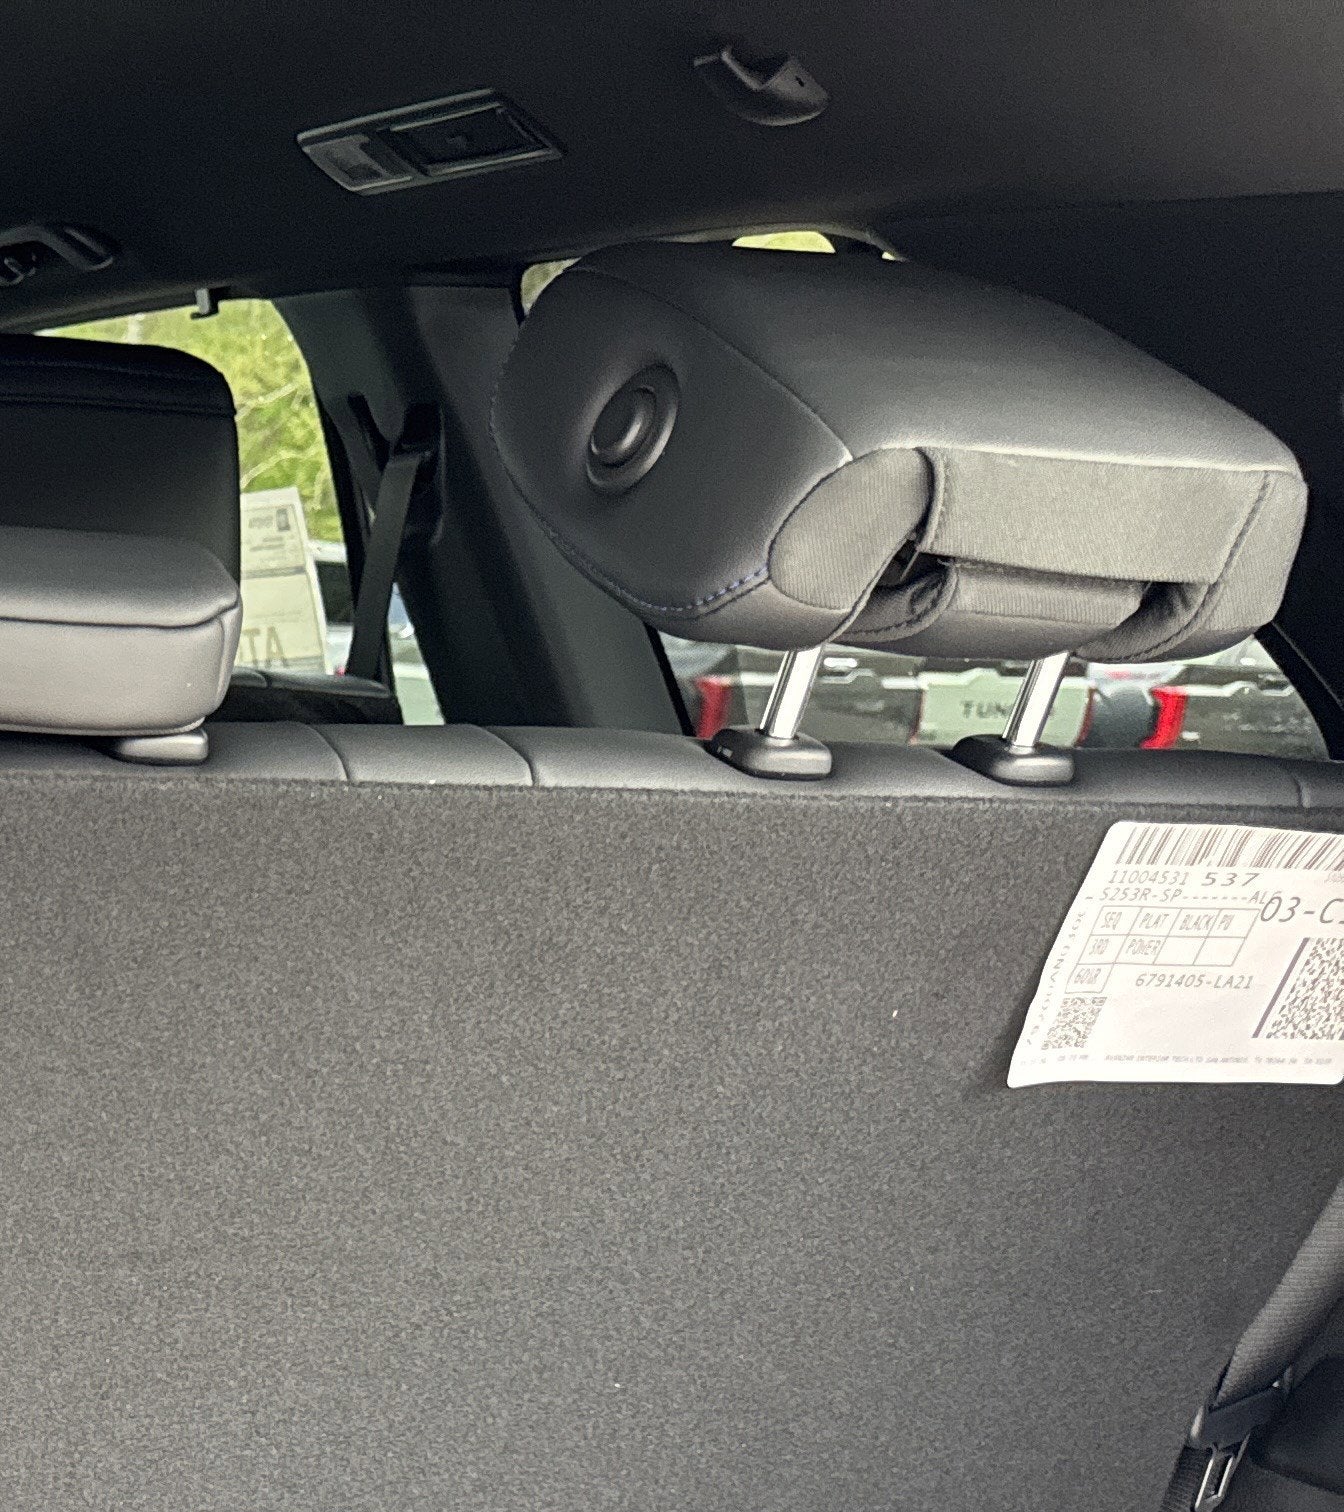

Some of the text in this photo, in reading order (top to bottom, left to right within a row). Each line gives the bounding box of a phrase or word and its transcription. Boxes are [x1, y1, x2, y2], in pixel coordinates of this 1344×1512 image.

[1108, 869, 1261, 888] 11004531 537
[1260, 896, 1344, 925] 03-C
[1134, 972, 1254, 990] 6791405-LA21
